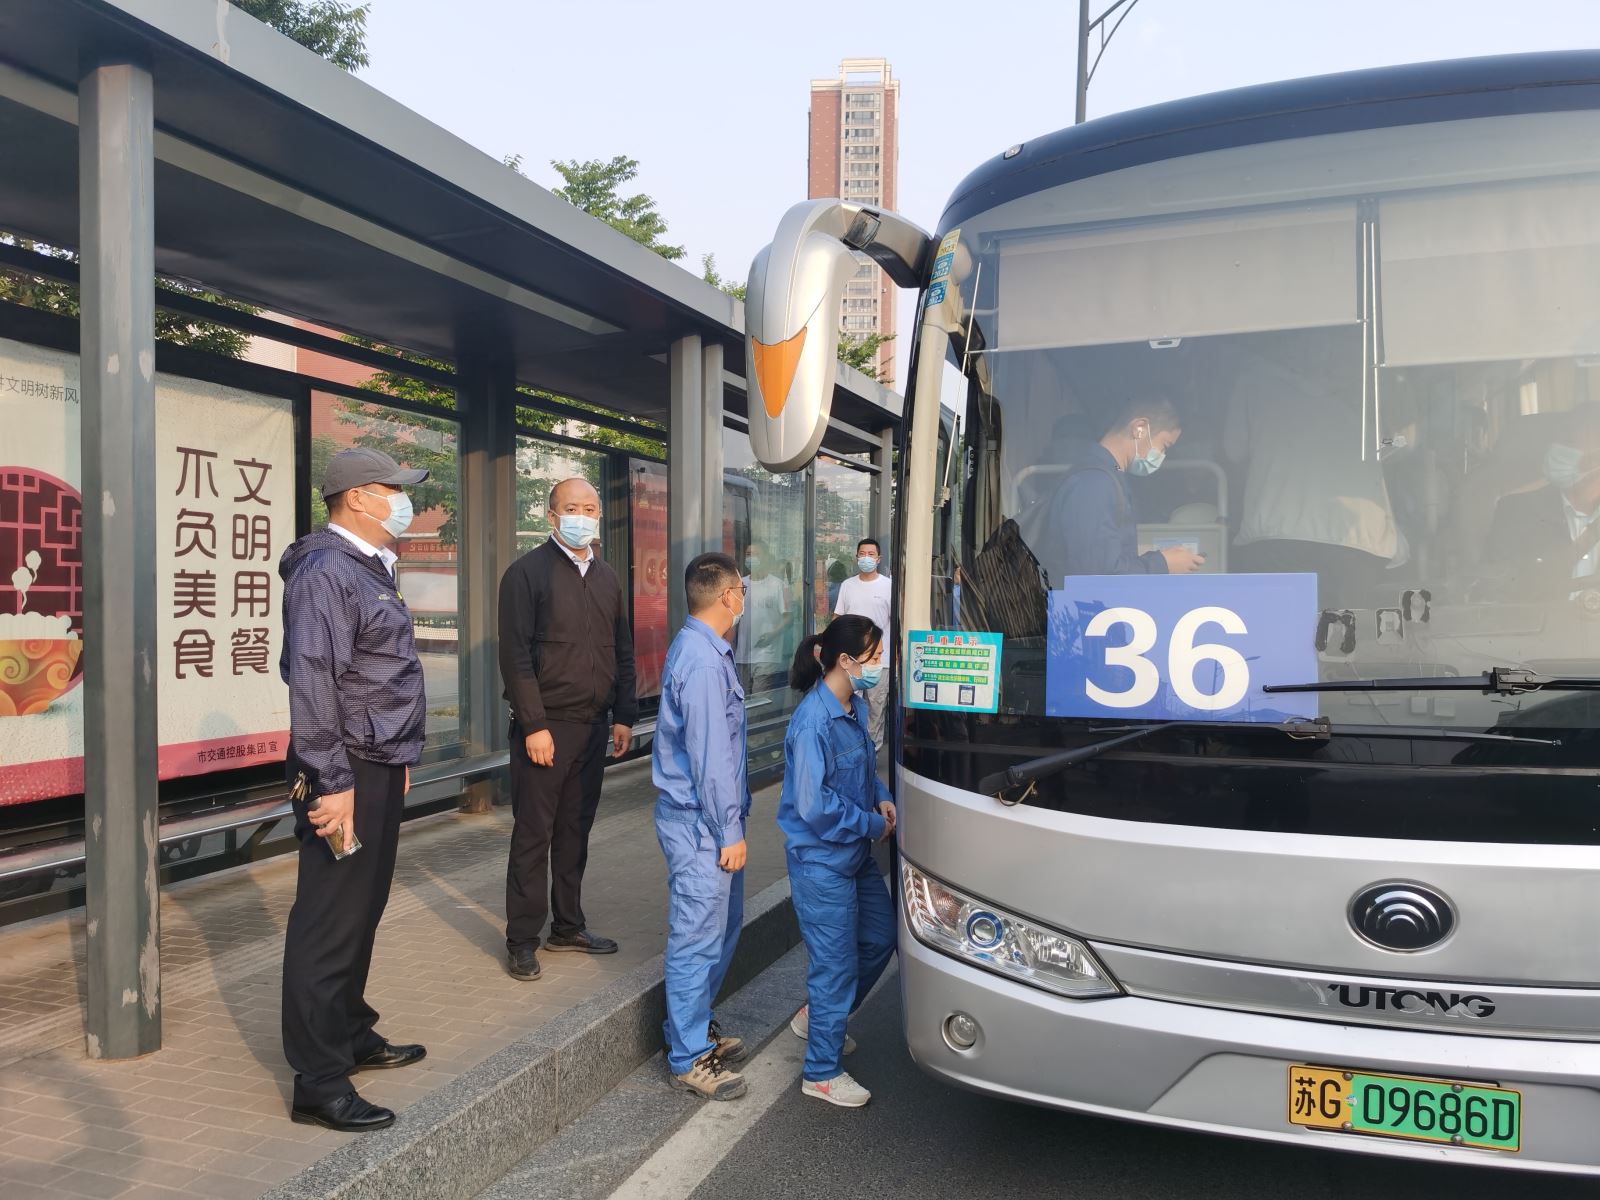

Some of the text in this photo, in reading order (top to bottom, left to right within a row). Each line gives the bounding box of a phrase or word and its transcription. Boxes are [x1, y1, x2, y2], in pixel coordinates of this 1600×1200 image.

[173, 446, 219, 680] 不负美食
[231, 457, 273, 676] 文明用餐
[1084, 606, 1249, 709] 36
[1306, 981, 1496, 1018] YUTONG
